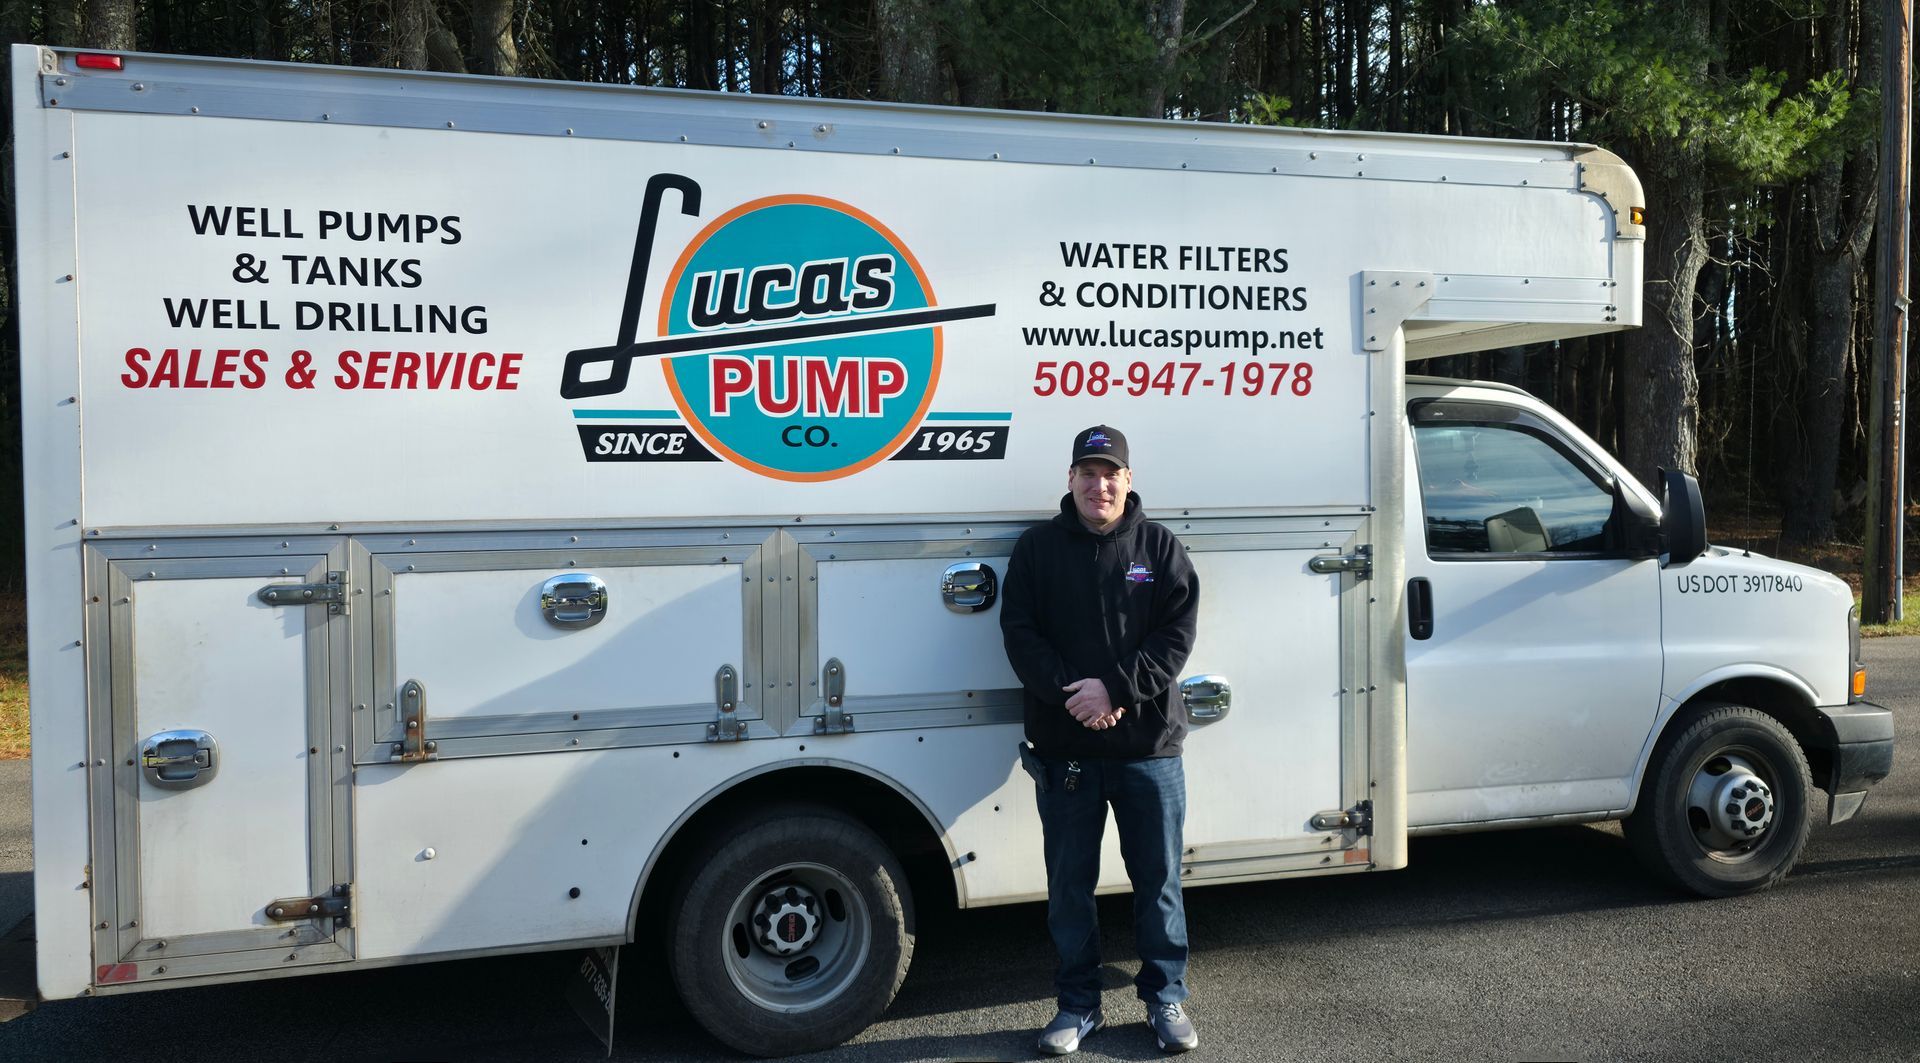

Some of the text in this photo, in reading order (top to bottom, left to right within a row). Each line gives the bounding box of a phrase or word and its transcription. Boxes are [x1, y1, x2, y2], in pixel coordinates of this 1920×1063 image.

[188, 204, 462, 245] WELL PUMPS
[232, 252, 422, 288] & TANKS
[1059, 241, 1289, 273] WATER FILTERS
[560, 173, 996, 399] Lucas
[1039, 280, 1308, 312] & CONDITIONERS
[163, 297, 488, 334] WELL DRILLING
[1022, 320, 1324, 356] www.lucaspump.net
[120, 347, 524, 390] SALES & SERVICE
[710, 355, 907, 417] PUMP
[1033, 360, 1313, 397] 508-947-1978
[594, 432, 687, 456] SINCE
[781, 425, 838, 448] CO.
[917, 430, 996, 453] 1965
[1743, 575, 1802, 593] 3917840
